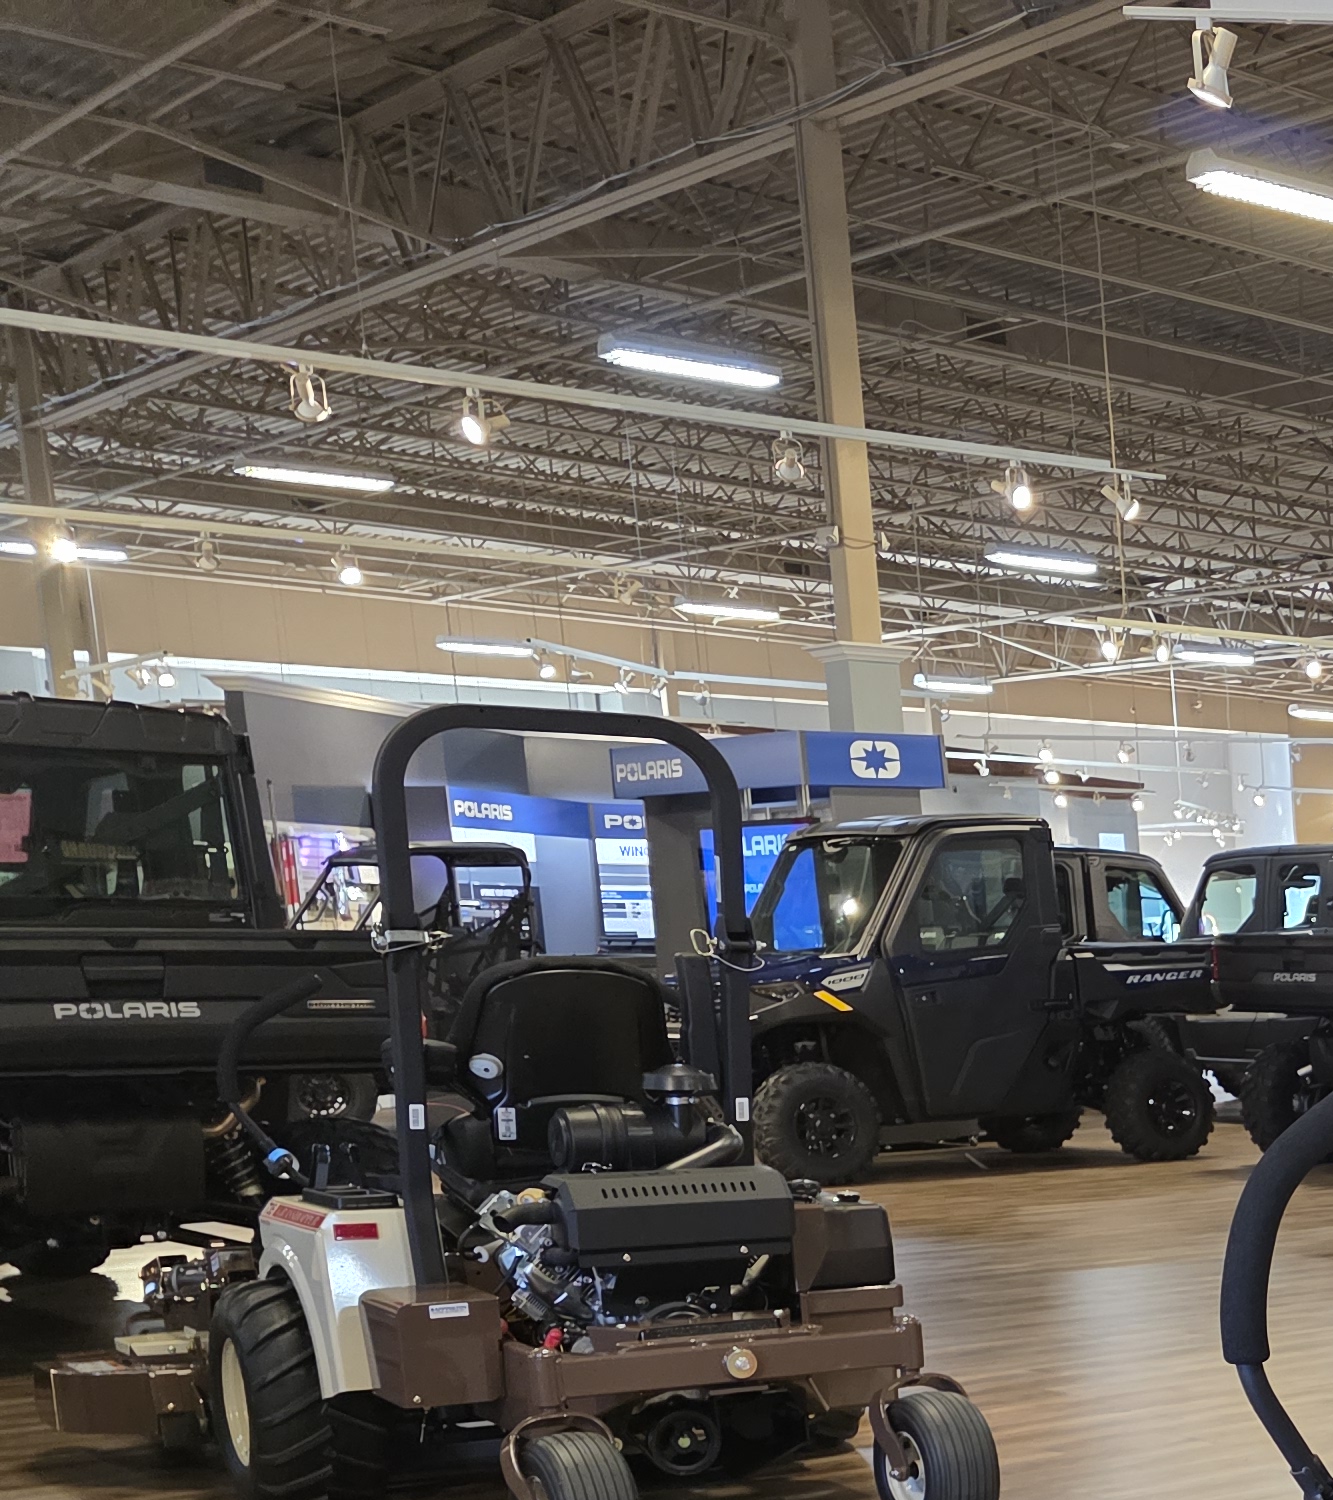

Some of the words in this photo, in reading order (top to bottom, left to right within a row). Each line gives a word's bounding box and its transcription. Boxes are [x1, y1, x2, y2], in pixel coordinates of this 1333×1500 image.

[615, 758, 683, 783] POLARIS
[453, 799, 513, 821] POLARIS
[1125, 968, 1204, 985] RANGER
[1272, 972, 1317, 983] POLARIS
[53, 1001, 201, 1020] POLARIS
